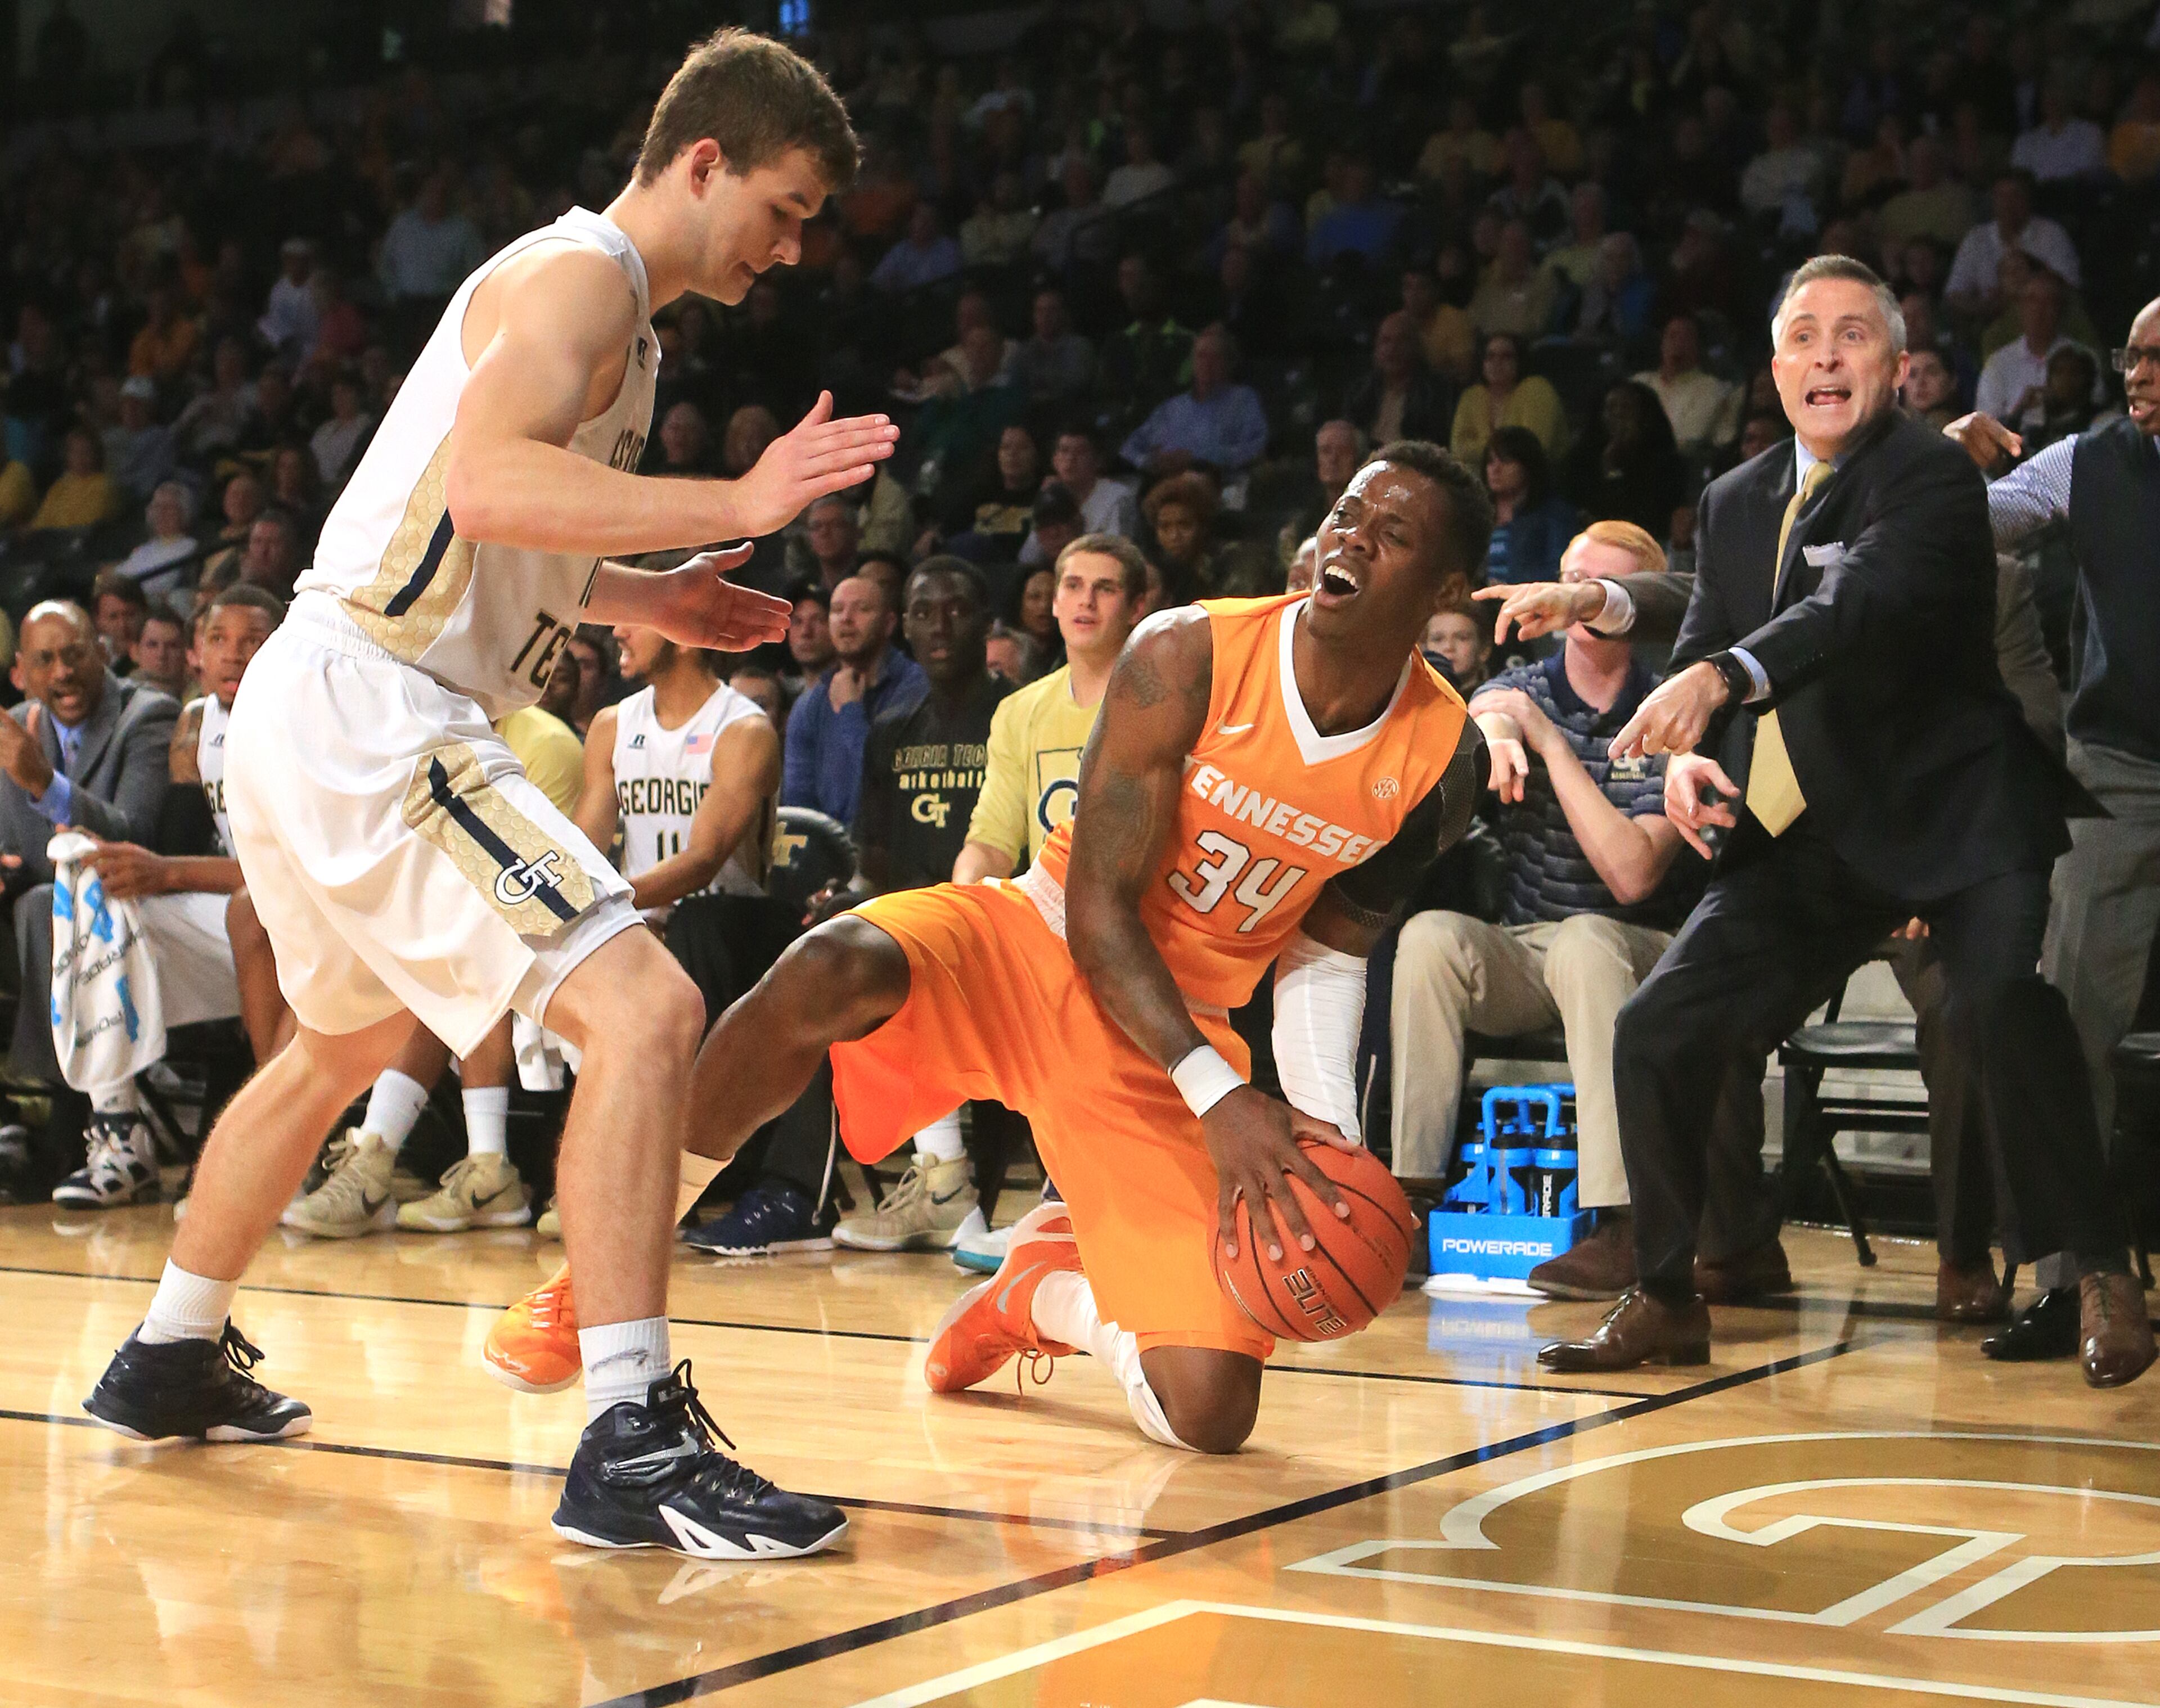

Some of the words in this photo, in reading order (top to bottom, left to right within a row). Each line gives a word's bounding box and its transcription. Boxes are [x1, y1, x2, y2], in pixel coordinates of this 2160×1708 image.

[911, 793, 951, 828] GT
[494, 849, 564, 905] GT
[1167, 830, 1310, 934] 34
[1442, 1238, 1554, 1257] POWERADE
[1282, 1268, 1348, 1336] ELITE
